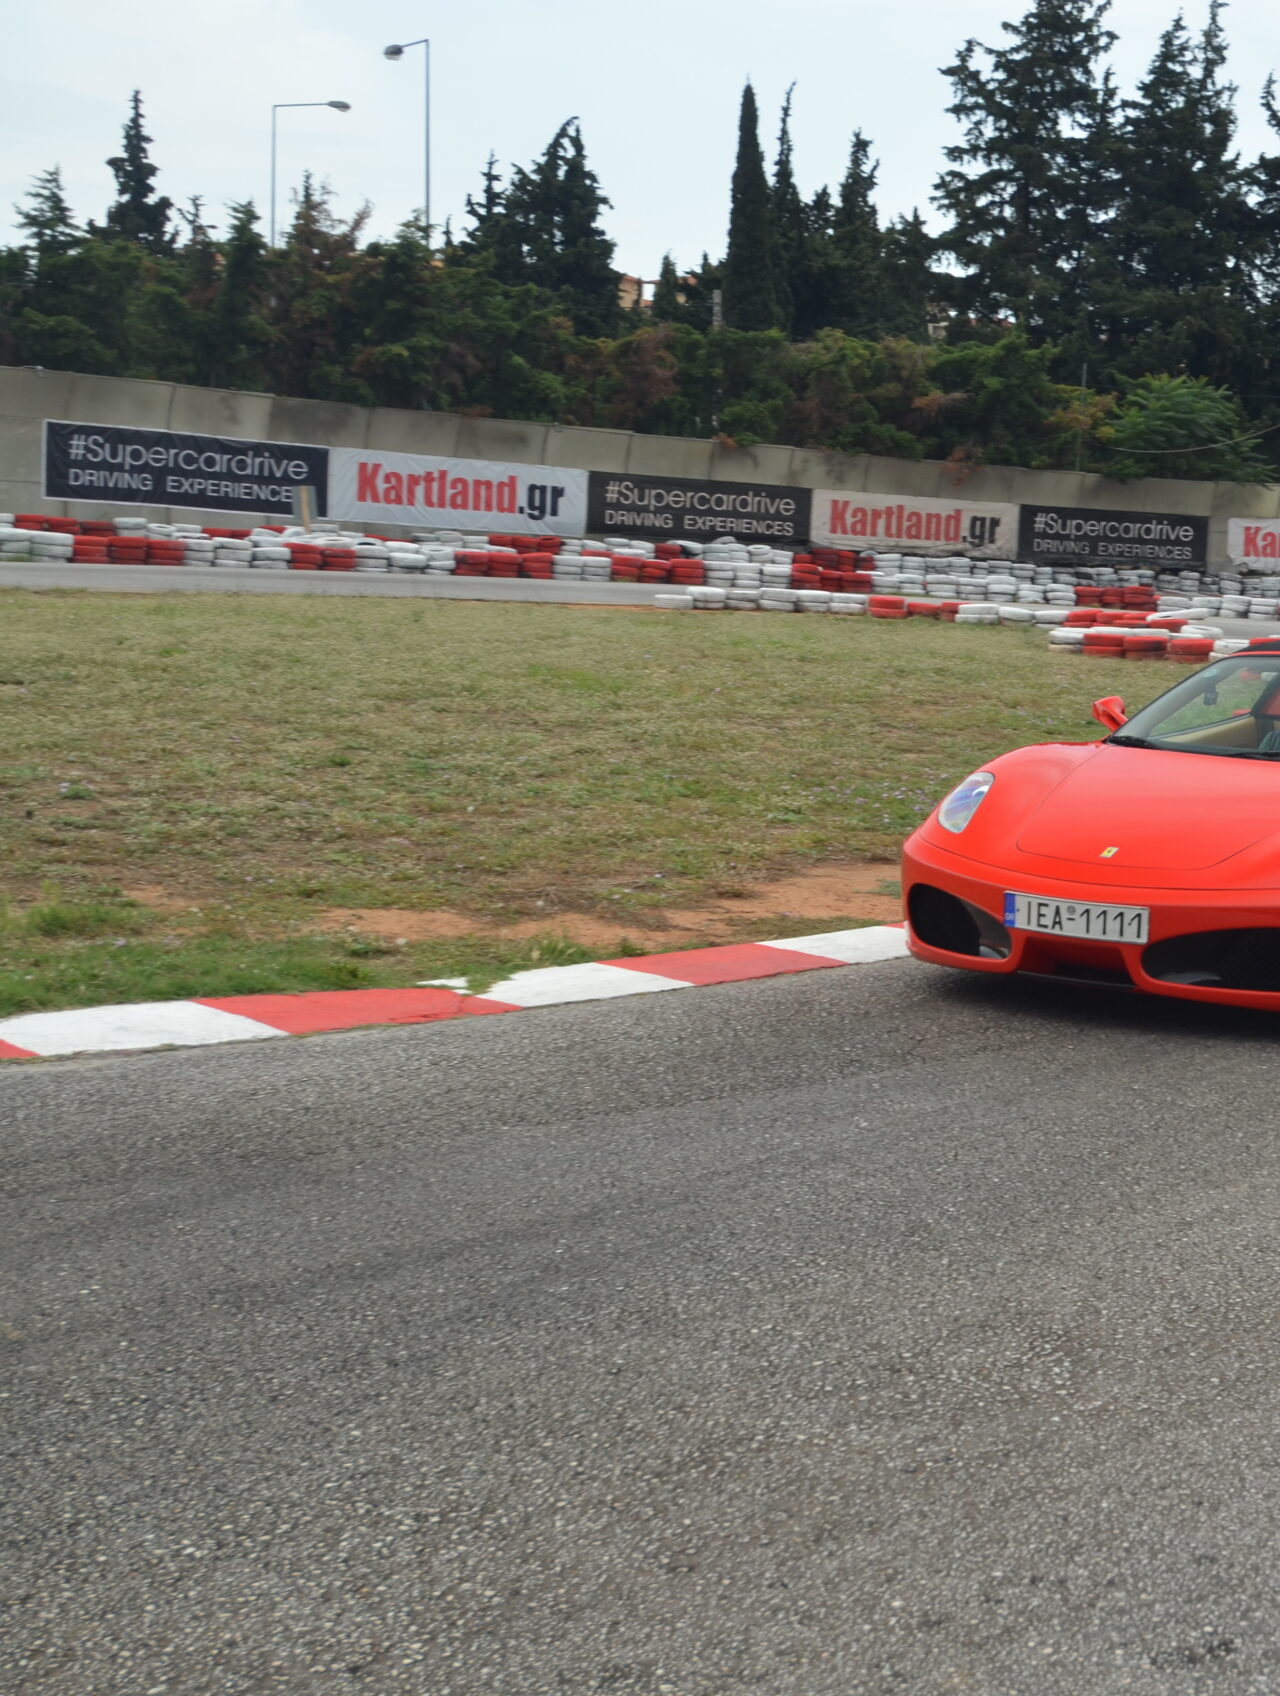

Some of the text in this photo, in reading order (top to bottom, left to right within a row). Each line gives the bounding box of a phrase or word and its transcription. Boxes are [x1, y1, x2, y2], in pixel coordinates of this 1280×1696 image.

[68, 434, 309, 480] #Supercardrive
[68, 469, 294, 502] DRIVING EXPERIENCE
[356, 461, 565, 521] Kartland.gr
[605, 480, 796, 515] #Supercardrive
[605, 510, 794, 536] DRIVING EXPERIENCES
[829, 499, 1000, 548] Kartland.gr
[1033, 512, 1194, 542] #Supercardrive
[1033, 538, 1192, 560] DRIVING EXPERIENCES
